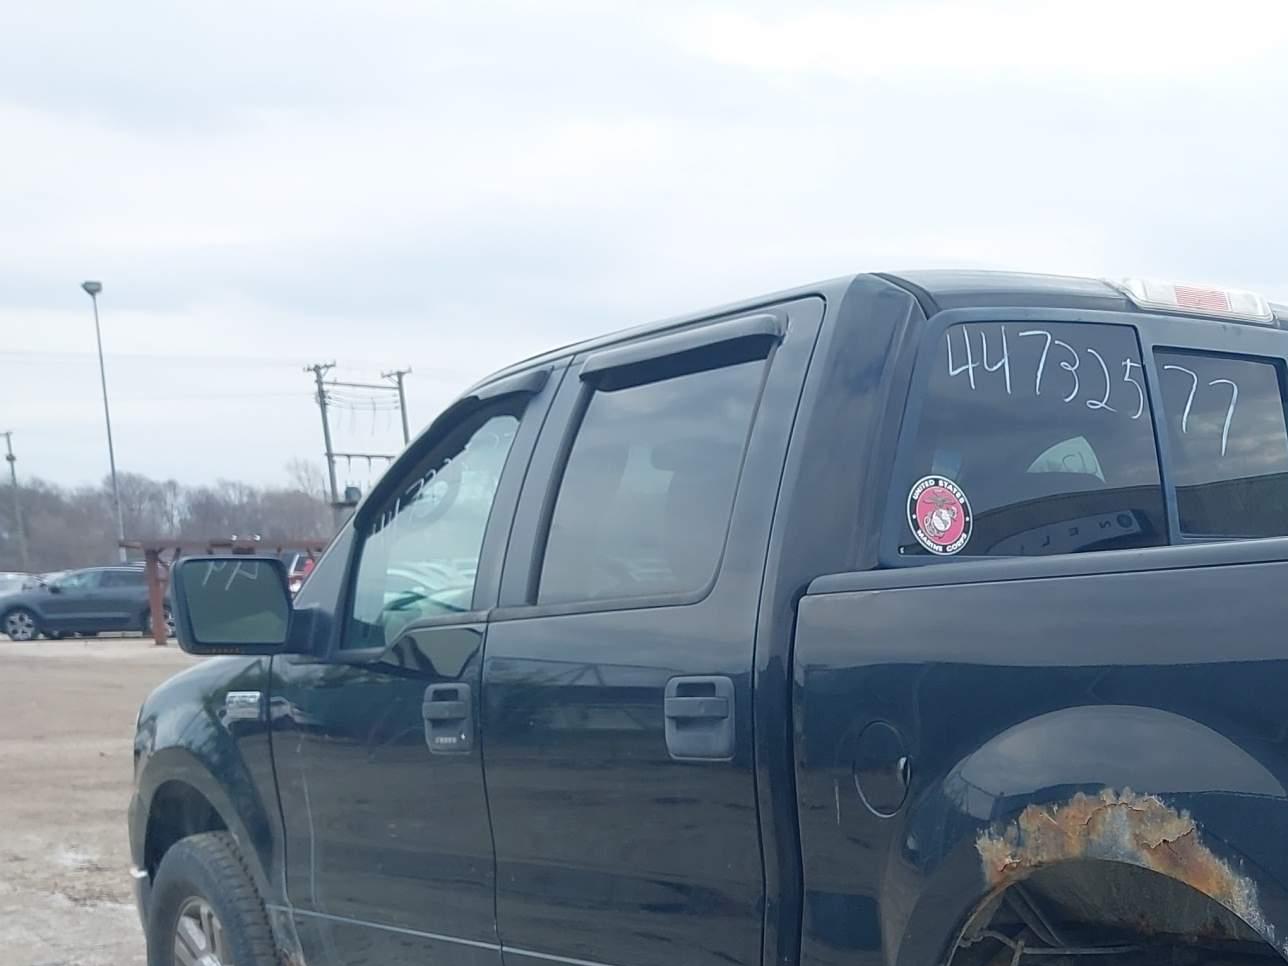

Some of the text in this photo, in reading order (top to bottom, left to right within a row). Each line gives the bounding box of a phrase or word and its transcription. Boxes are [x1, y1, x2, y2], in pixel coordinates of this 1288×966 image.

[912, 479, 965, 504] UNITED STATES
[916, 529, 943, 552] MARINE
[945, 532, 967, 552] CORPS
